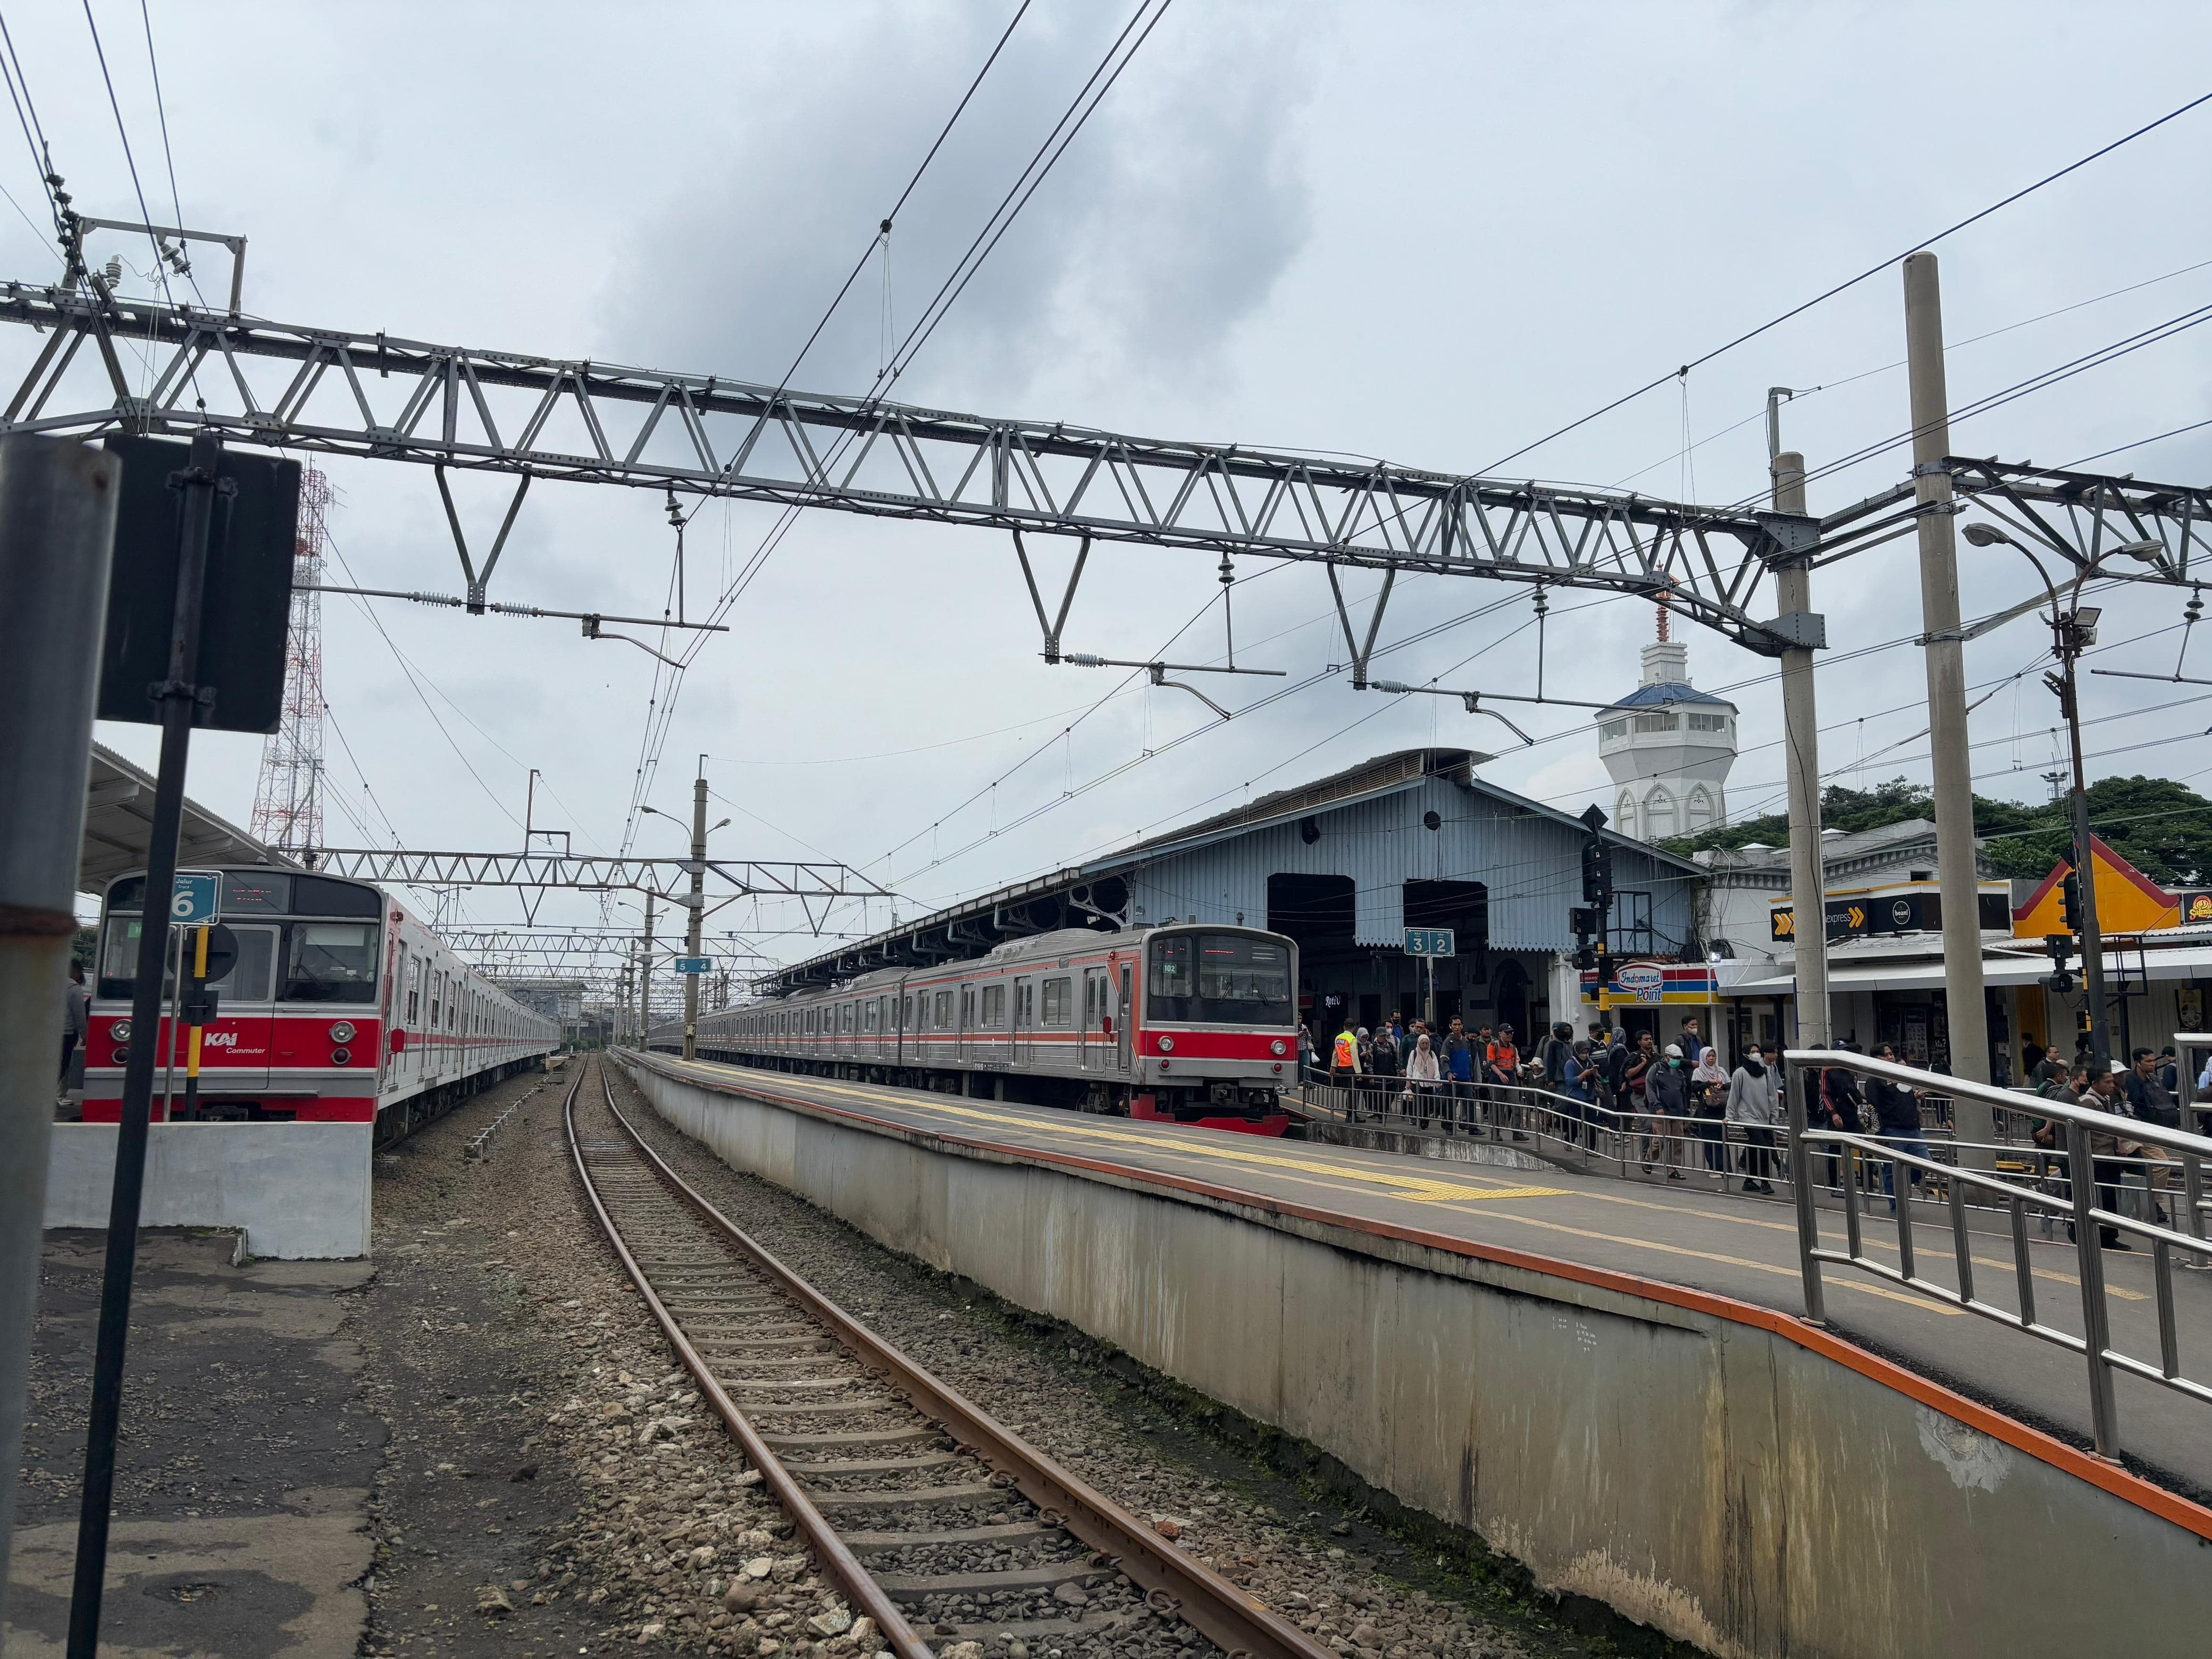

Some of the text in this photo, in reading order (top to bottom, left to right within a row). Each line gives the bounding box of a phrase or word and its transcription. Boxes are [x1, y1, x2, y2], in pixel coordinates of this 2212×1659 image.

[171, 891, 194, 917] 6
[1413, 938, 1422, 951] 3
[1437, 939, 1446, 952] 2
[1620, 971, 1660, 984] Indomaret
[1636, 986, 1662, 1002] Point
[204, 1033, 238, 1046] KAI
